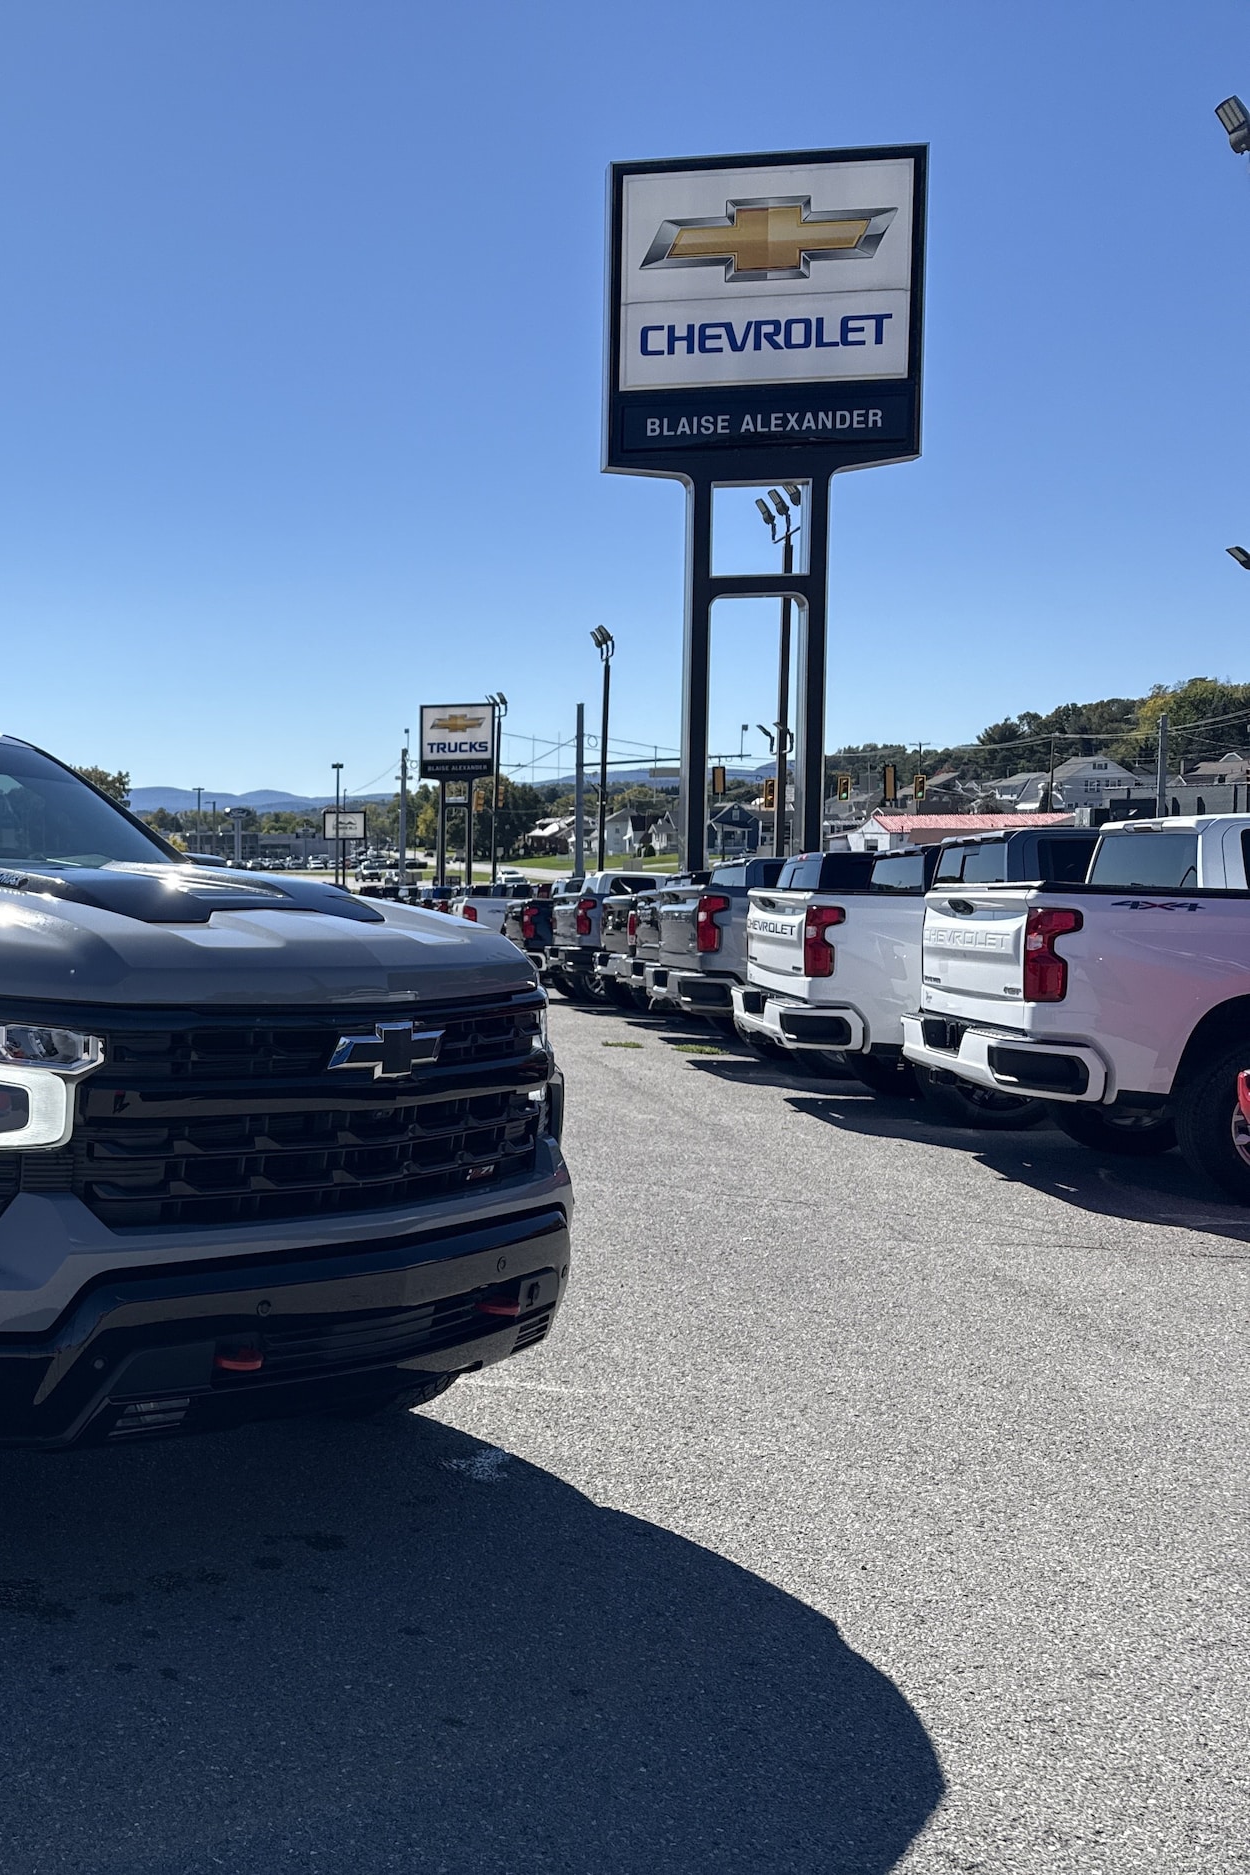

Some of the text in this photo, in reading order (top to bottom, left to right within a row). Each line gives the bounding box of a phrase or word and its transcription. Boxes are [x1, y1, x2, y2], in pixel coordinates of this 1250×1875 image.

[640, 313, 893, 356] CHEVROLET
[646, 408, 883, 437] BLAISE ALEXANDER
[427, 741, 489, 754] TRUCKS
[747, 918, 796, 936] CHEVROLET
[924, 929, 1011, 949] CHEVROLET
